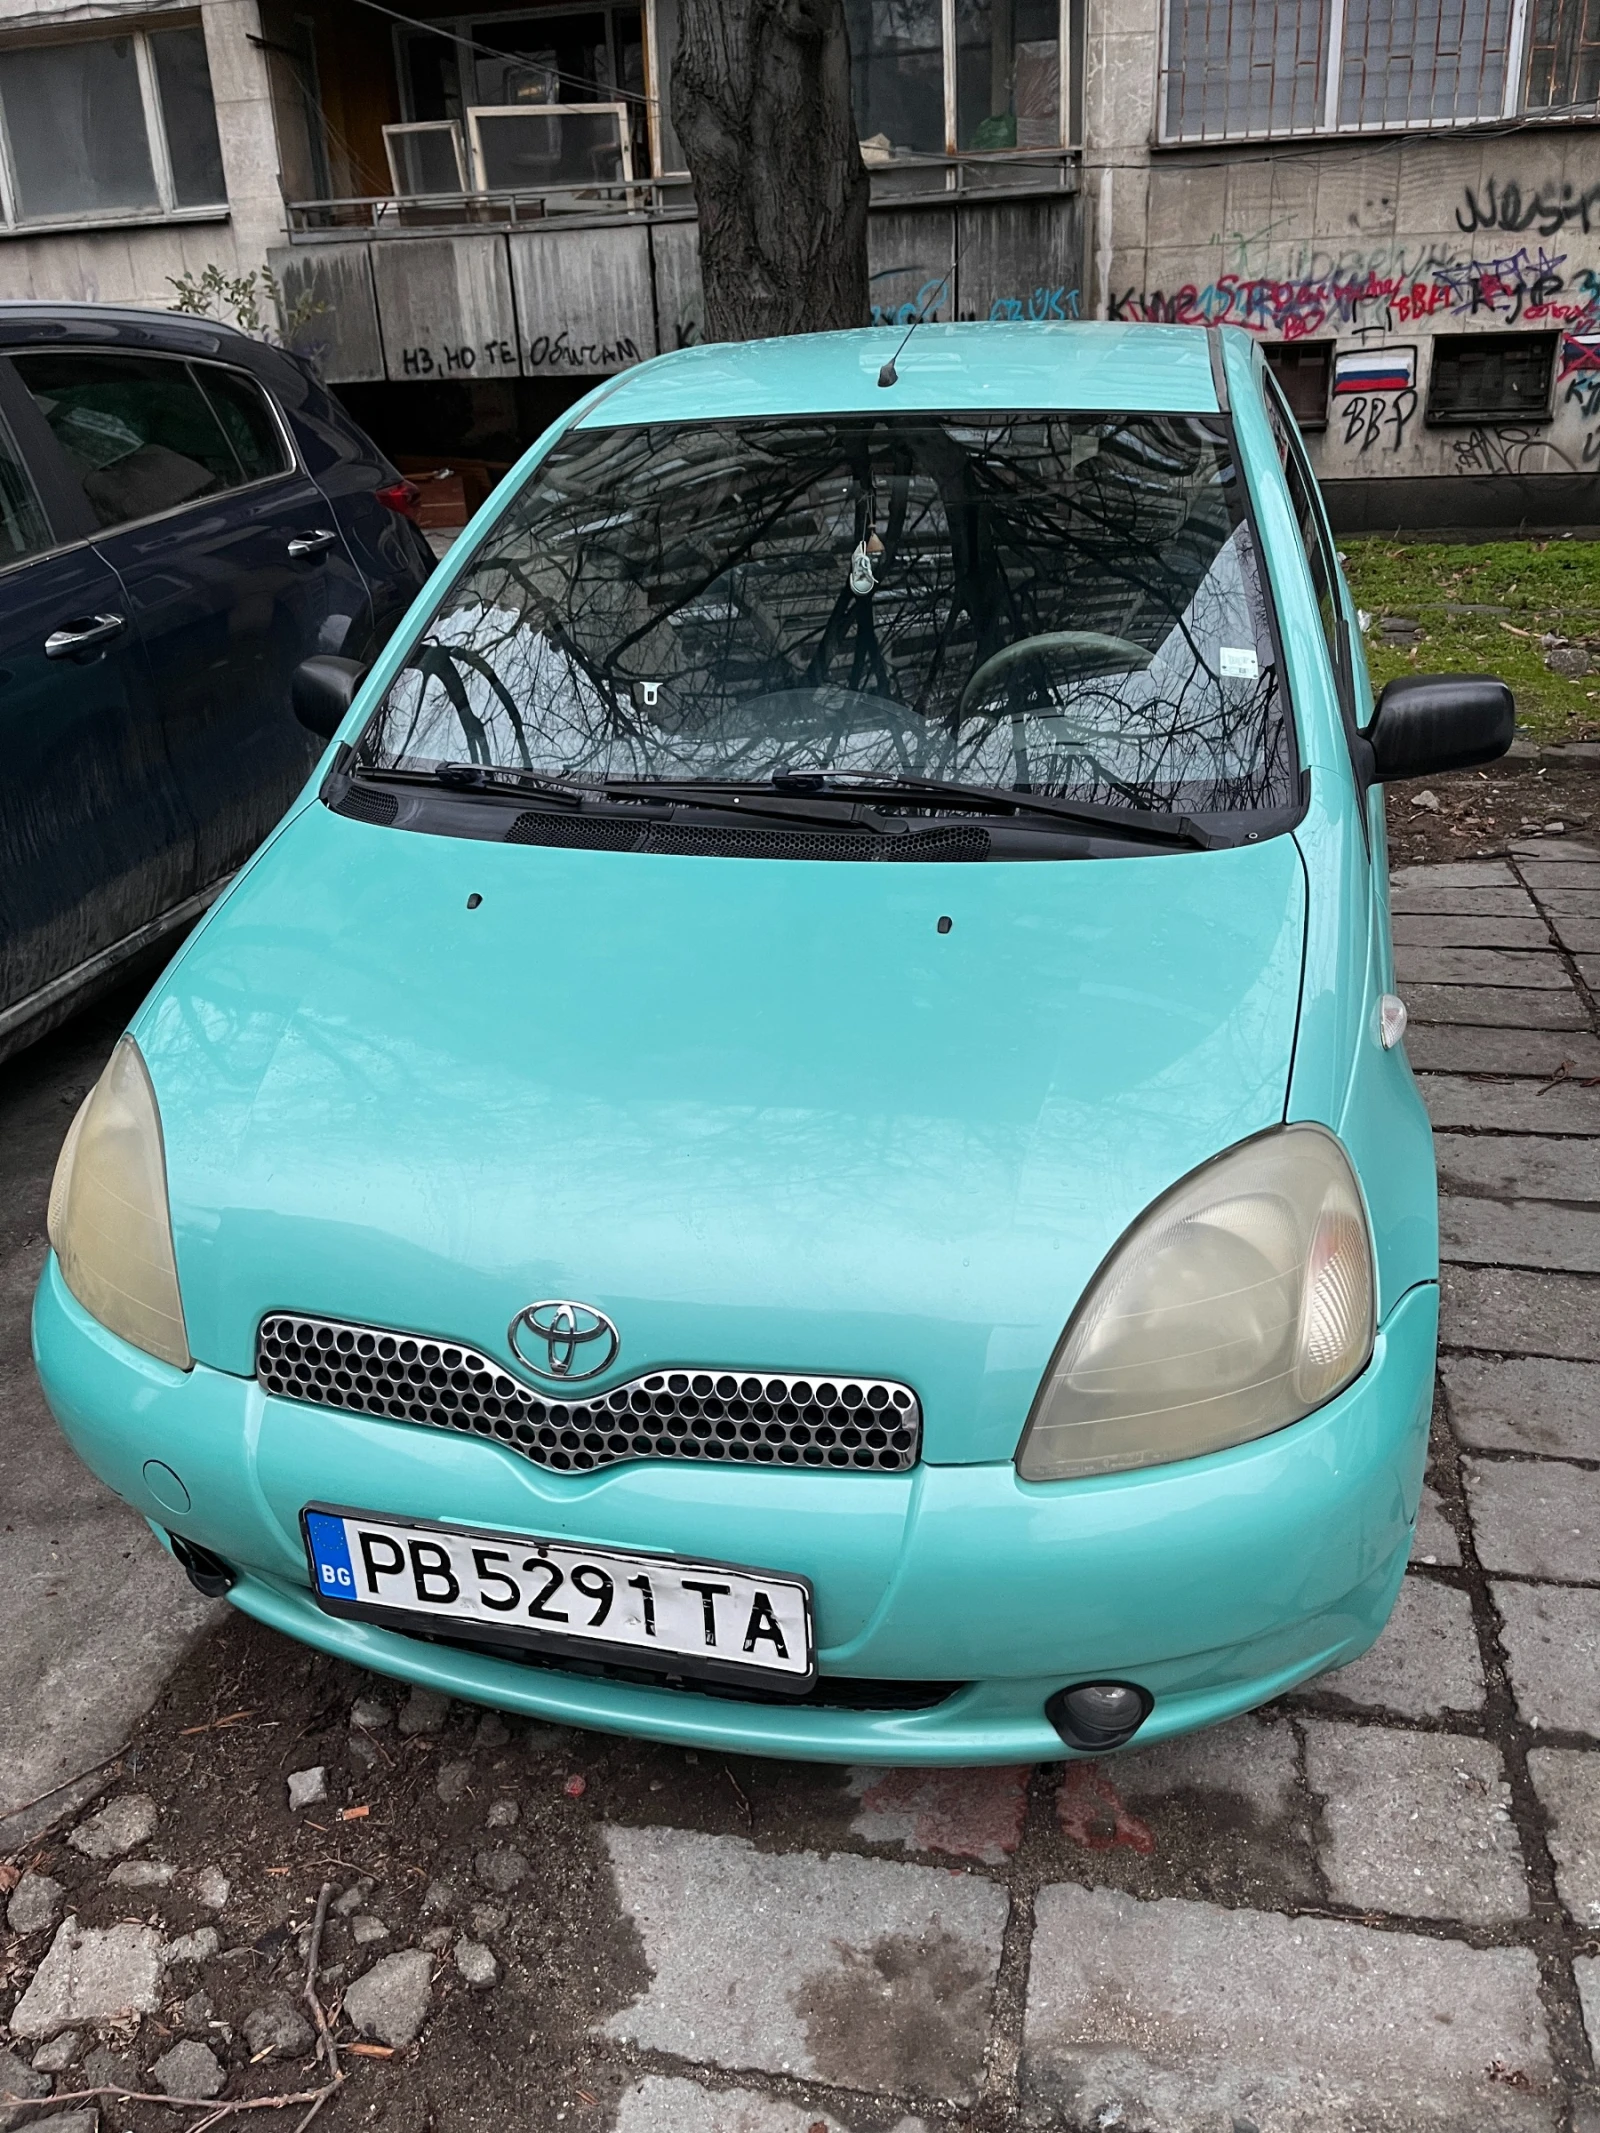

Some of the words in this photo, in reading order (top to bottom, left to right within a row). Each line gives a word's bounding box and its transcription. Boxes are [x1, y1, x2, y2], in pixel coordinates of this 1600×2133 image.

[484, 340, 516, 364] ТЕ
[321, 1564, 351, 1587] BG
[358, 1530, 460, 1604] PB
[471, 1546, 657, 1637] 5291
[681, 1579, 790, 1659] TA
